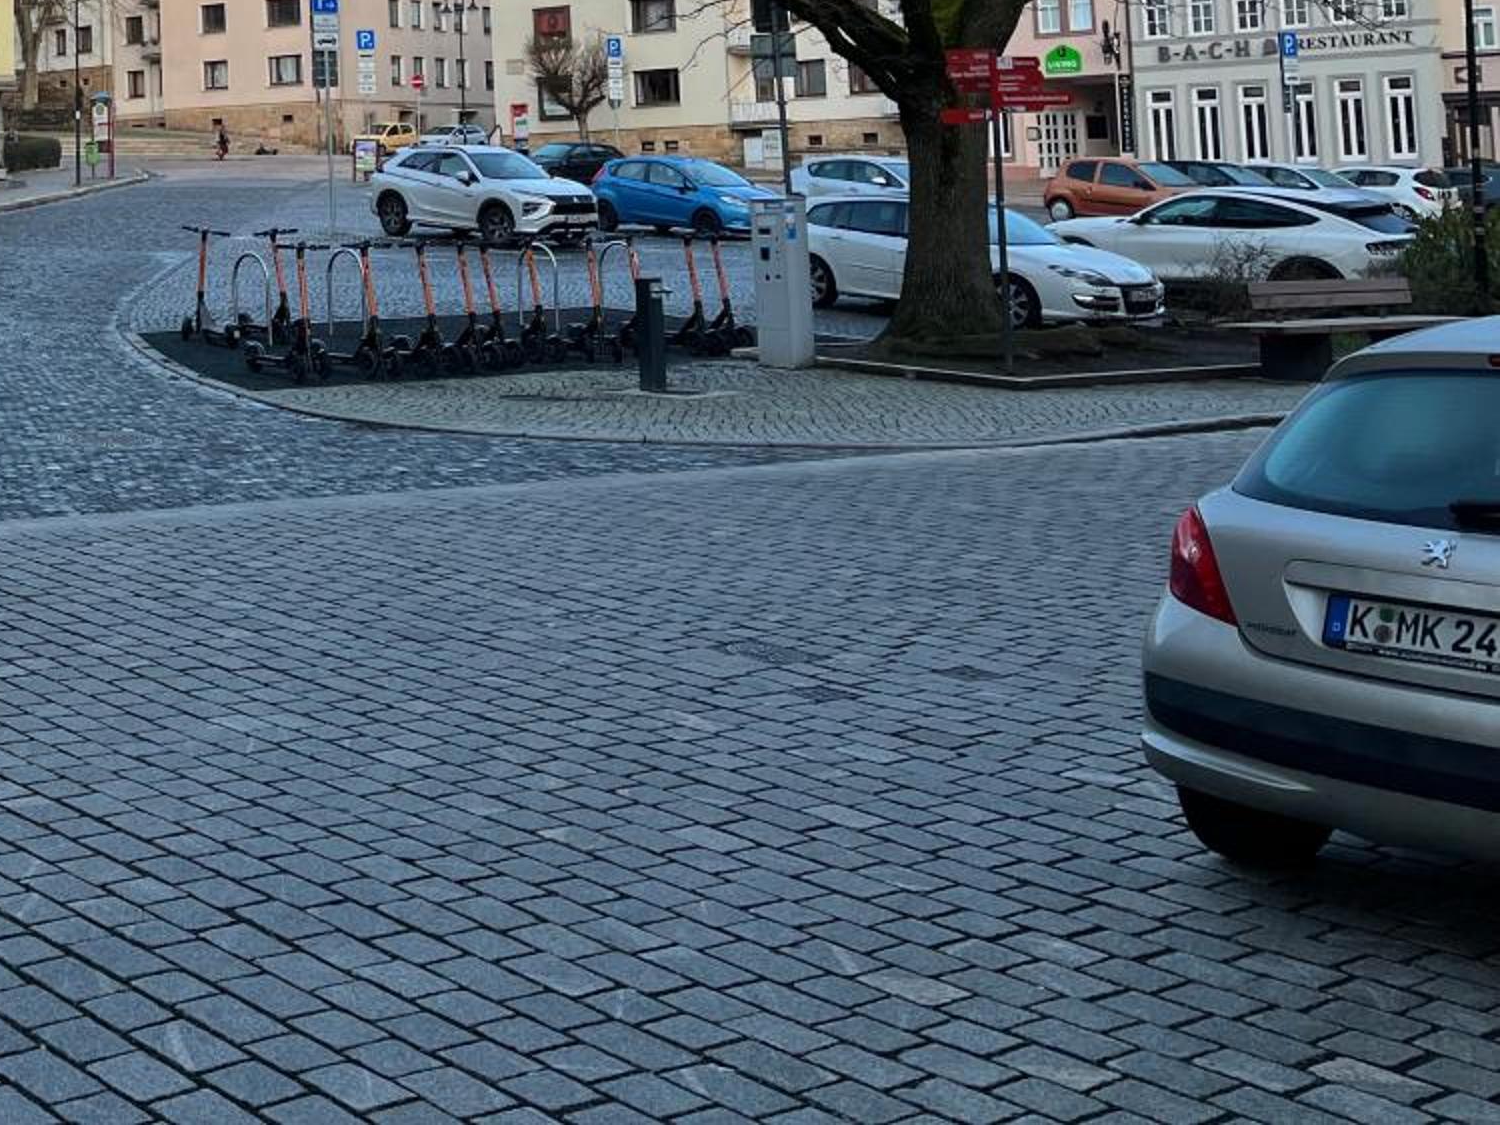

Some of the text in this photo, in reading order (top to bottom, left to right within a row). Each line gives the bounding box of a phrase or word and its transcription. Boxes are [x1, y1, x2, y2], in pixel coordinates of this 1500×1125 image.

[360, 32, 371, 48] P
[1283, 35, 1294, 54] P
[1299, 30, 1414, 50] RESTAURANT
[1350, 604, 1375, 639] K
[1396, 610, 1445, 650] MK
